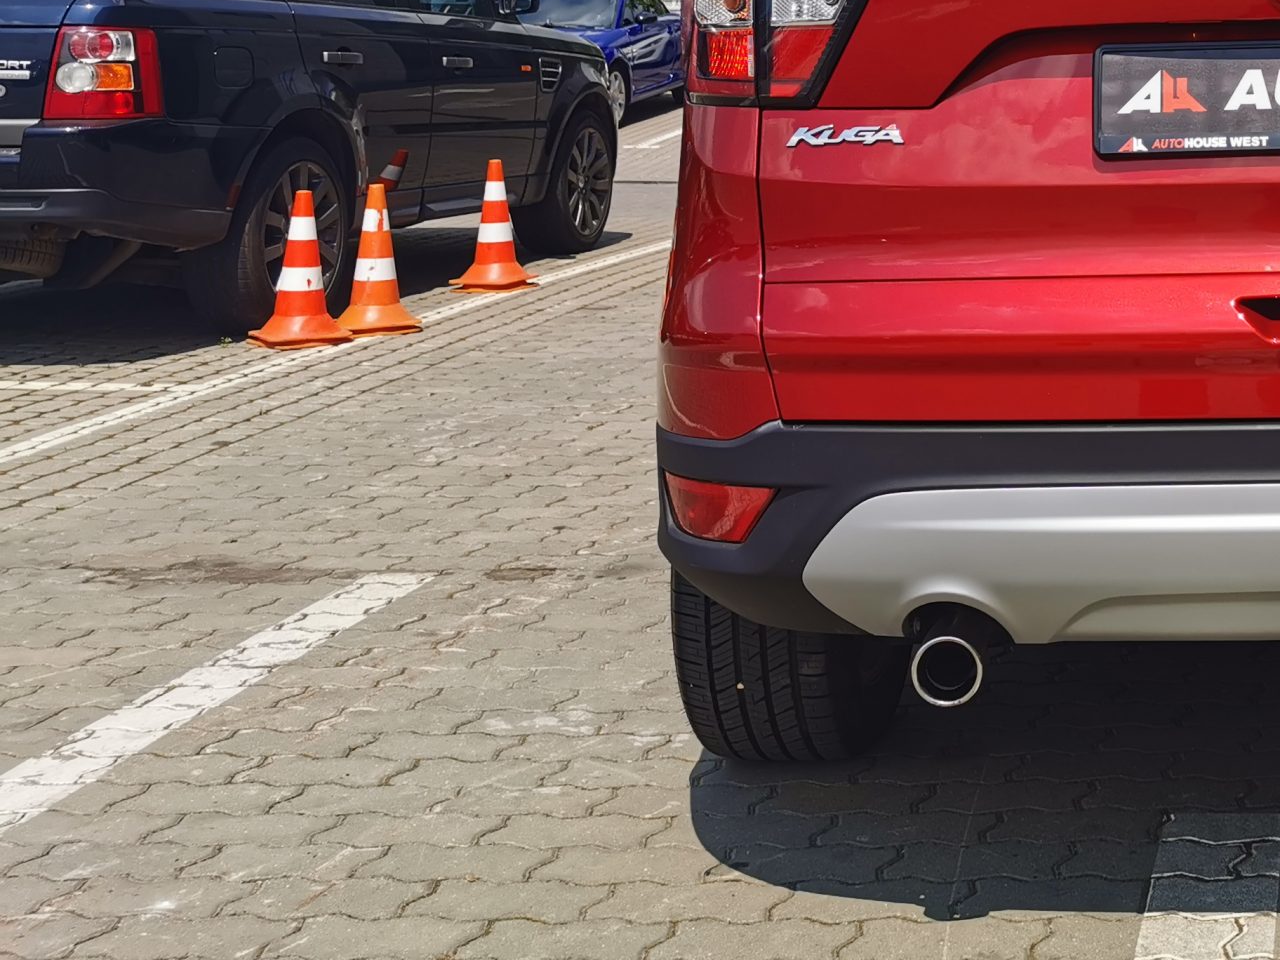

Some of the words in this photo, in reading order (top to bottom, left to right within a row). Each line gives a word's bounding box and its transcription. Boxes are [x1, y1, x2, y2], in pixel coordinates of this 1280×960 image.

[786, 124, 904, 147] KUGA
[1151, 136, 1227, 149] AUTOHOUSE
[1229, 136, 1269, 147] WEST
